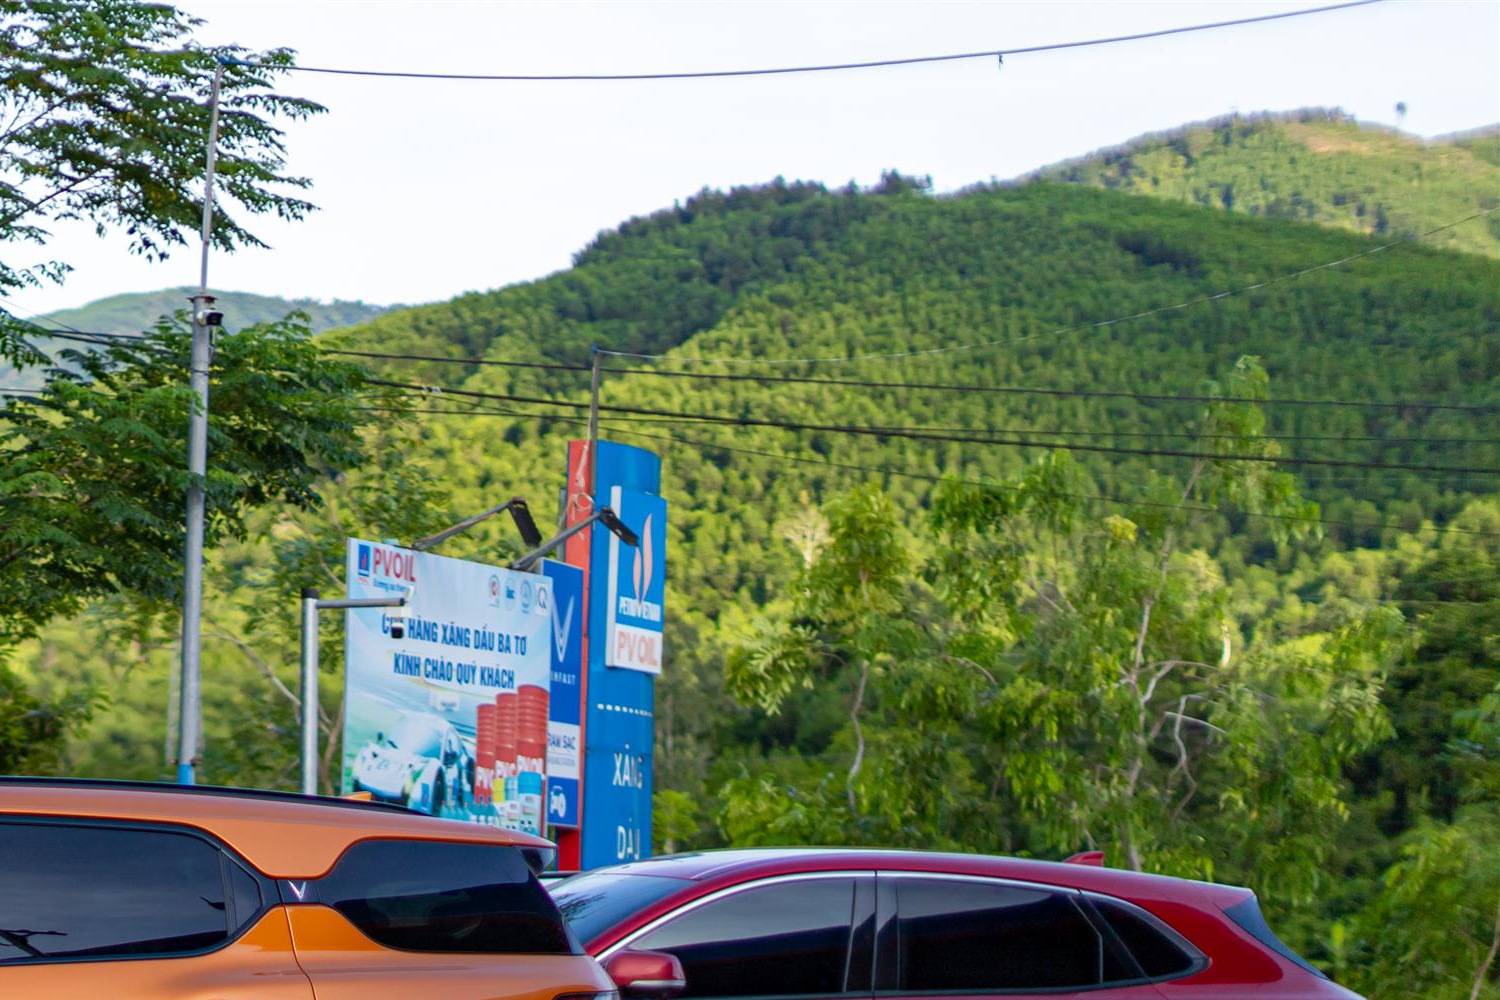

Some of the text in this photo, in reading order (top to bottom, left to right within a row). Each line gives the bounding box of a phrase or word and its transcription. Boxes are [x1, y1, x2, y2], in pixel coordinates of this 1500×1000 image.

[373, 547, 416, 582] PVOIL
[408, 615, 438, 642] HÀNG
[498, 633, 511, 653] BA
[393, 649, 421, 677] KÍNH
[551, 671, 576, 685] INFAST
